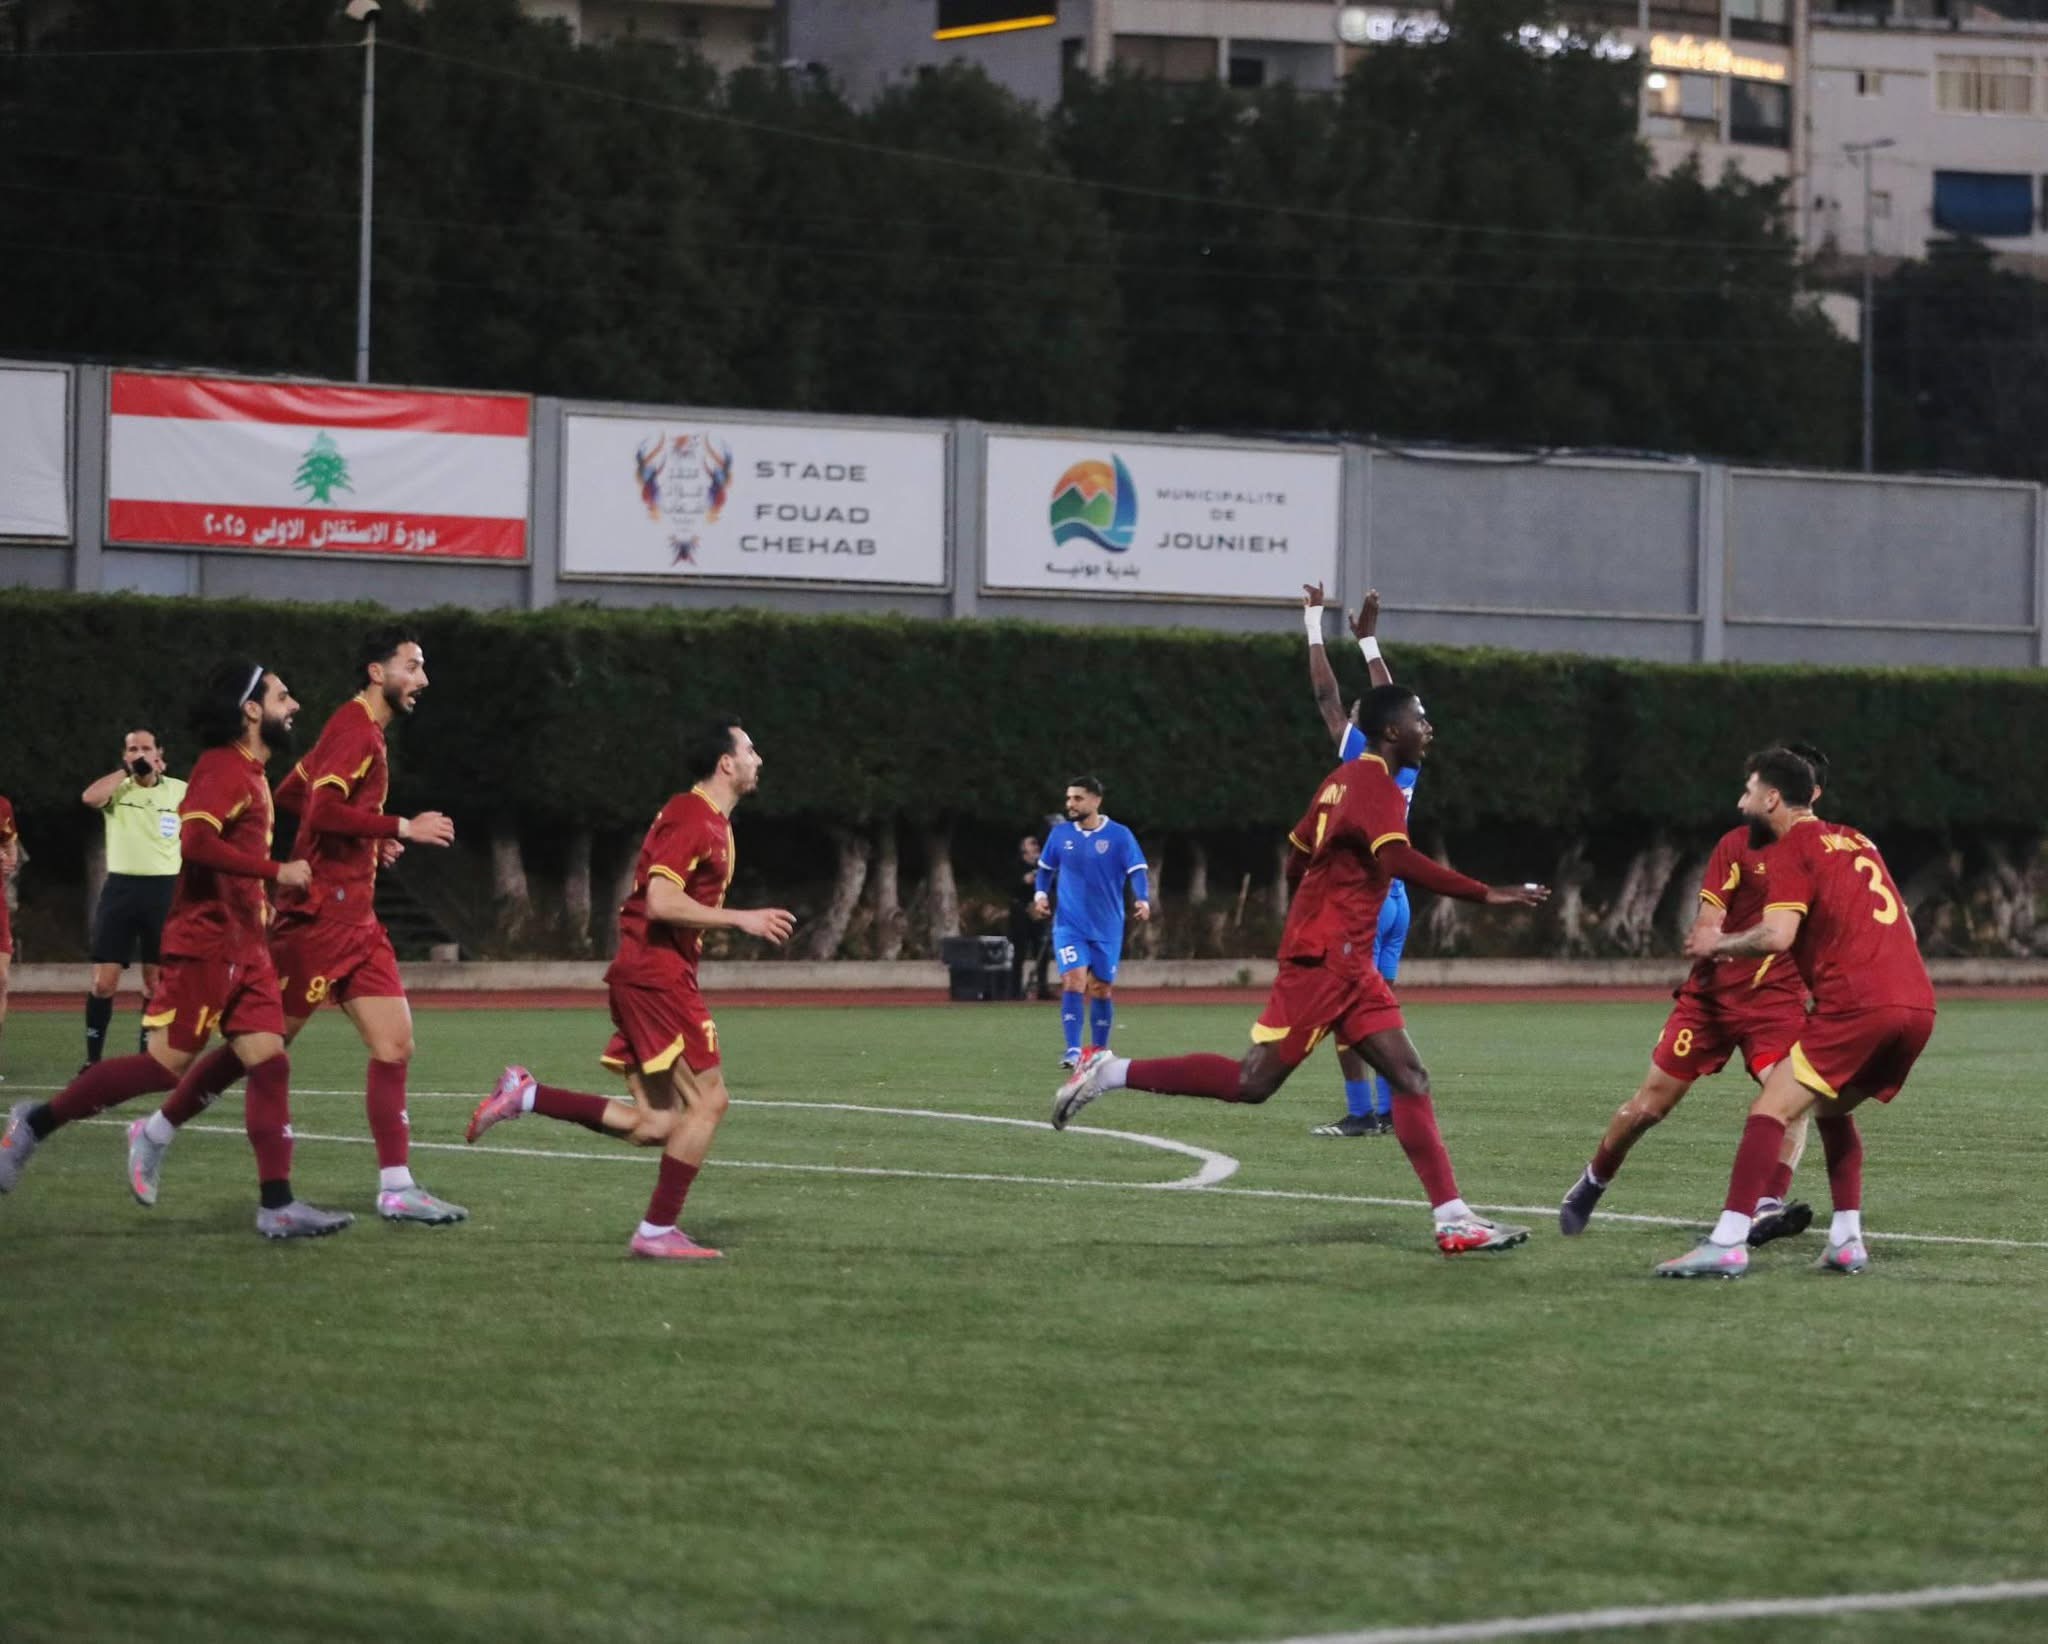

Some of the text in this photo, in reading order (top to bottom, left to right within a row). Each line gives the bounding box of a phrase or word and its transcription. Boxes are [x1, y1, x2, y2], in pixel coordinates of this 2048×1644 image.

[756, 461, 867, 481] STADE
[1156, 488, 1287, 505] MUNICIPALITE
[756, 503, 870, 524] FOUAD
[1210, 508, 1236, 522] DE
[204, 512, 247, 538] ٢٠٢٥
[310, 518, 390, 548] الاستقلال
[393, 520, 438, 550] دورة
[740, 535, 877, 556] CHEHAB
[1157, 532, 1288, 553] JOUNIEH
[1106, 559, 1140, 581] بلدية
[1854, 856, 1899, 925] 3
[1059, 945, 1079, 965] 15
[1673, 1028, 1694, 1057] 8
